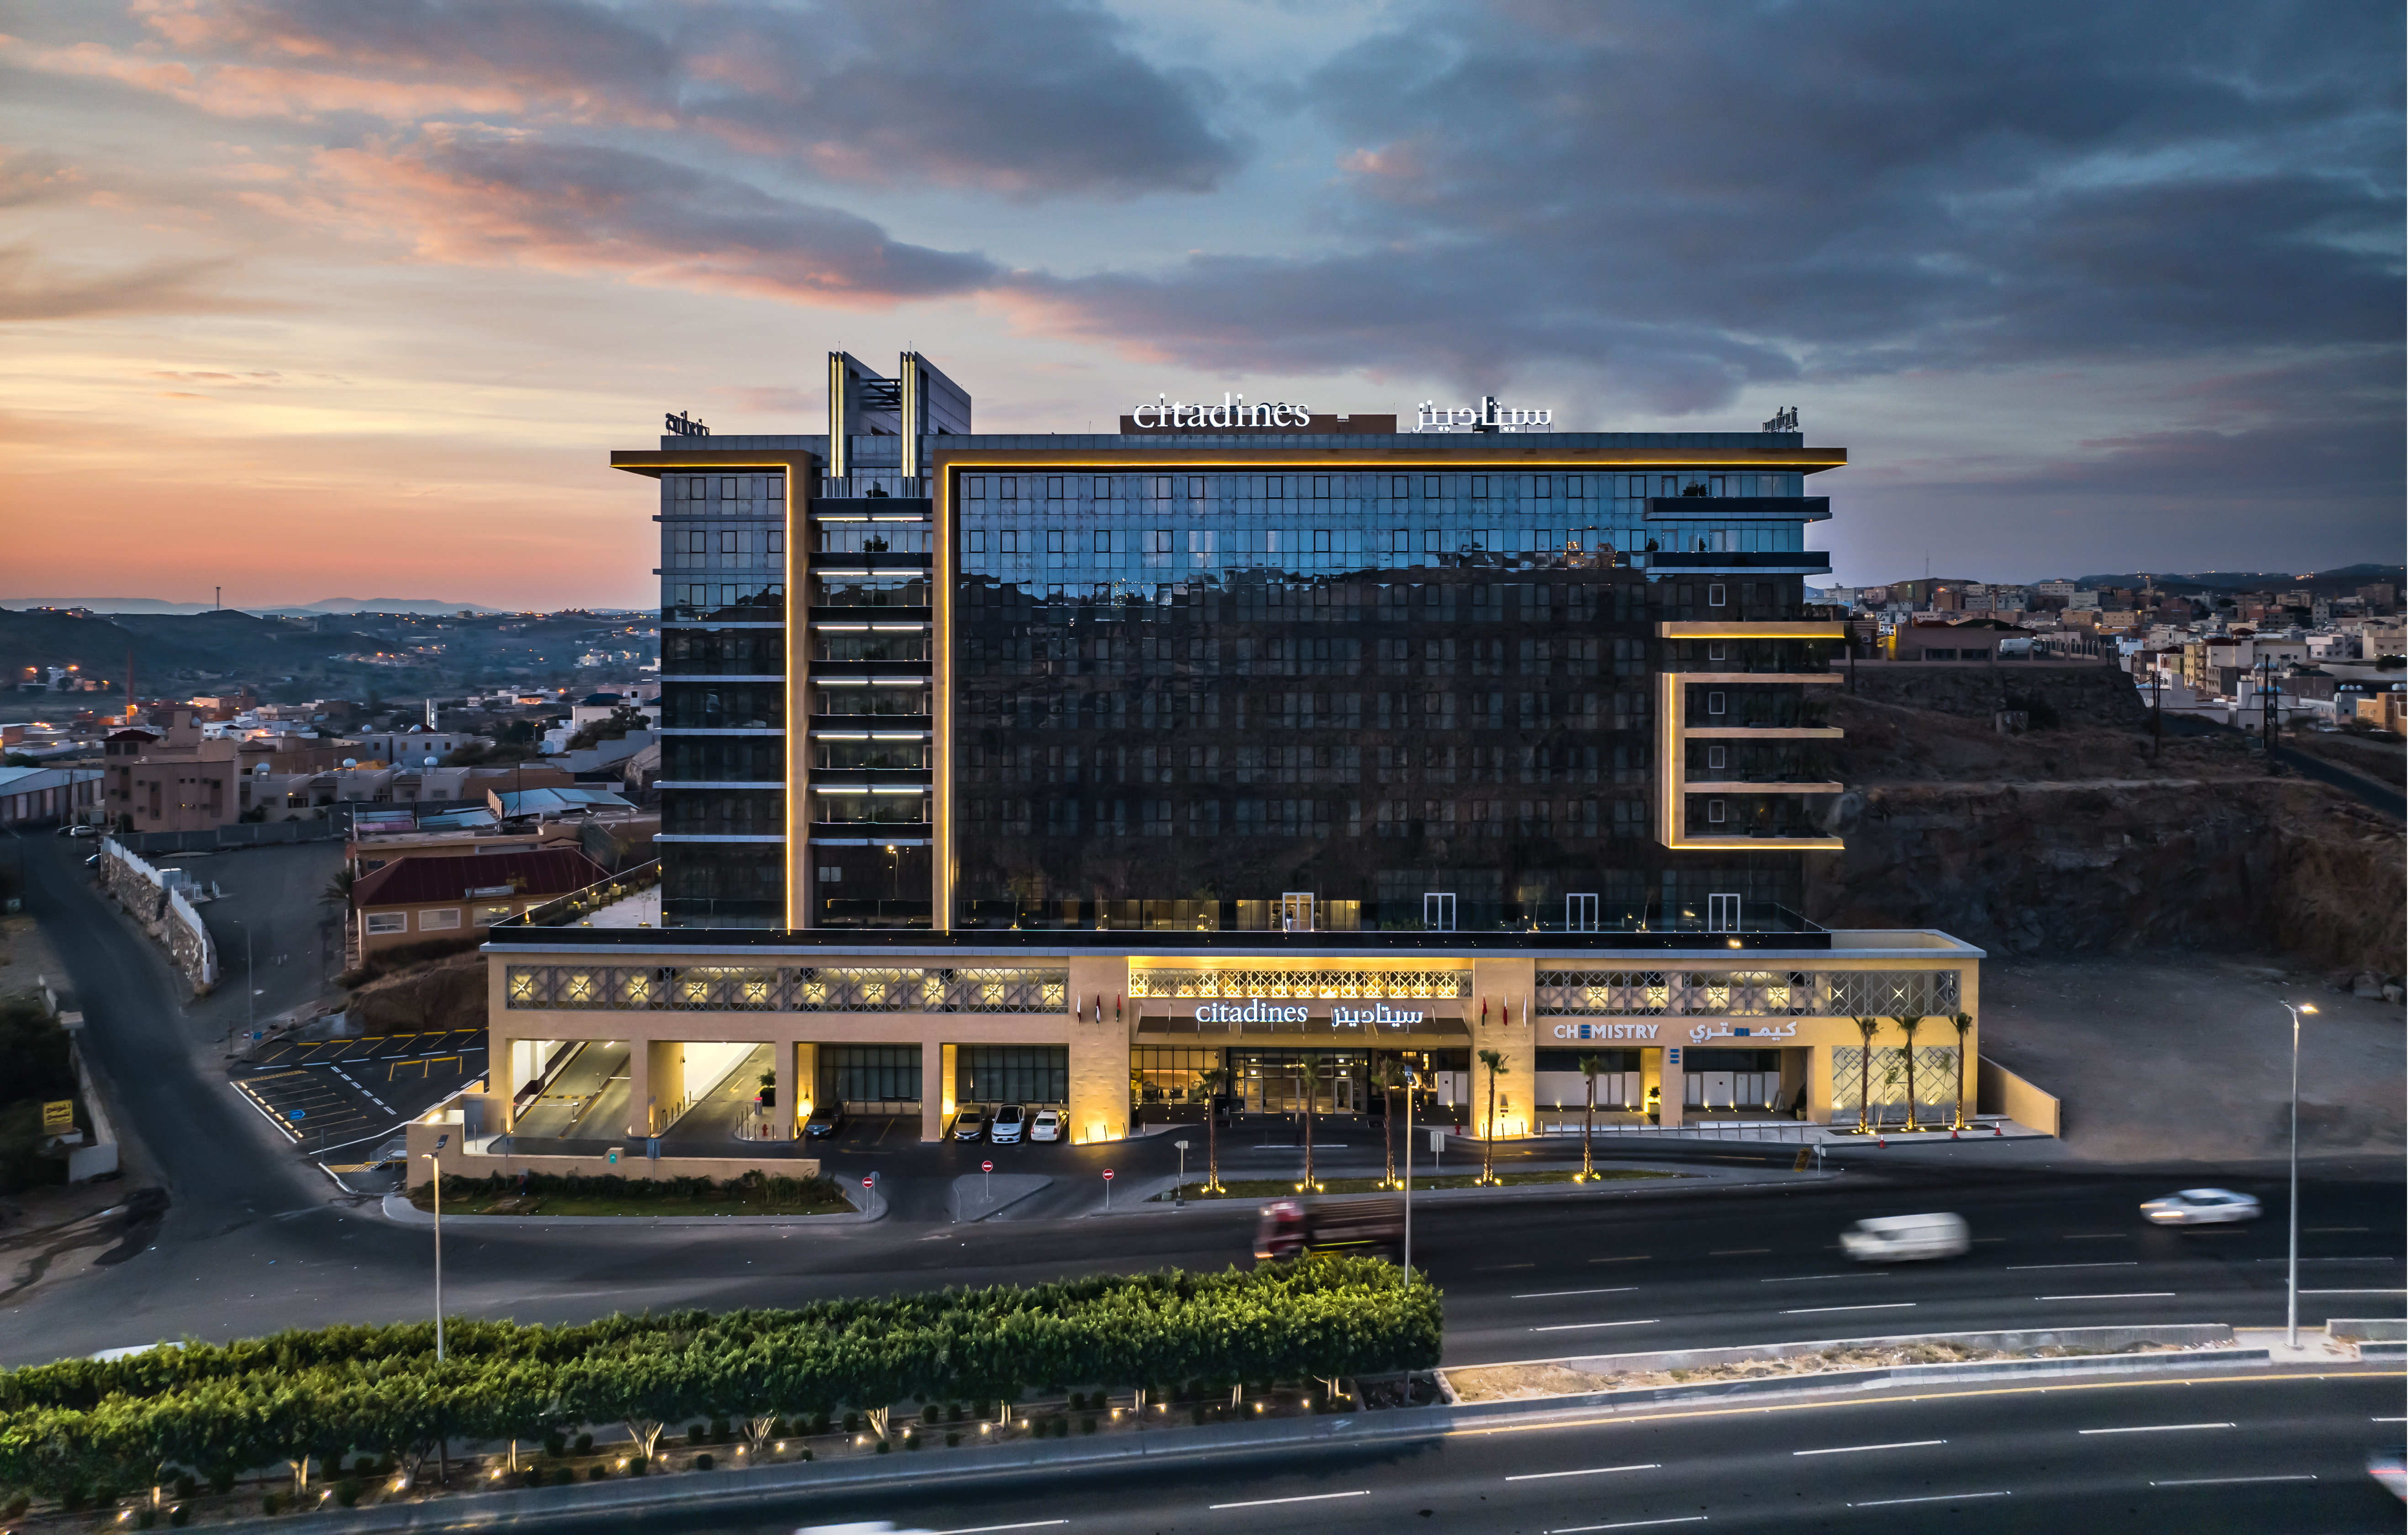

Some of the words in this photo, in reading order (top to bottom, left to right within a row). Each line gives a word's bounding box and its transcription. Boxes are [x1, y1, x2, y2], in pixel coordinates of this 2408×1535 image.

[1133, 391, 1310, 428] citadines
[1412, 396, 1552, 432] سيتادينز
[1196, 998, 1308, 1022] citadines
[1332, 1003, 1423, 1027] سيتادينز
[1554, 1024, 1659, 1039] CHEMISTRY
